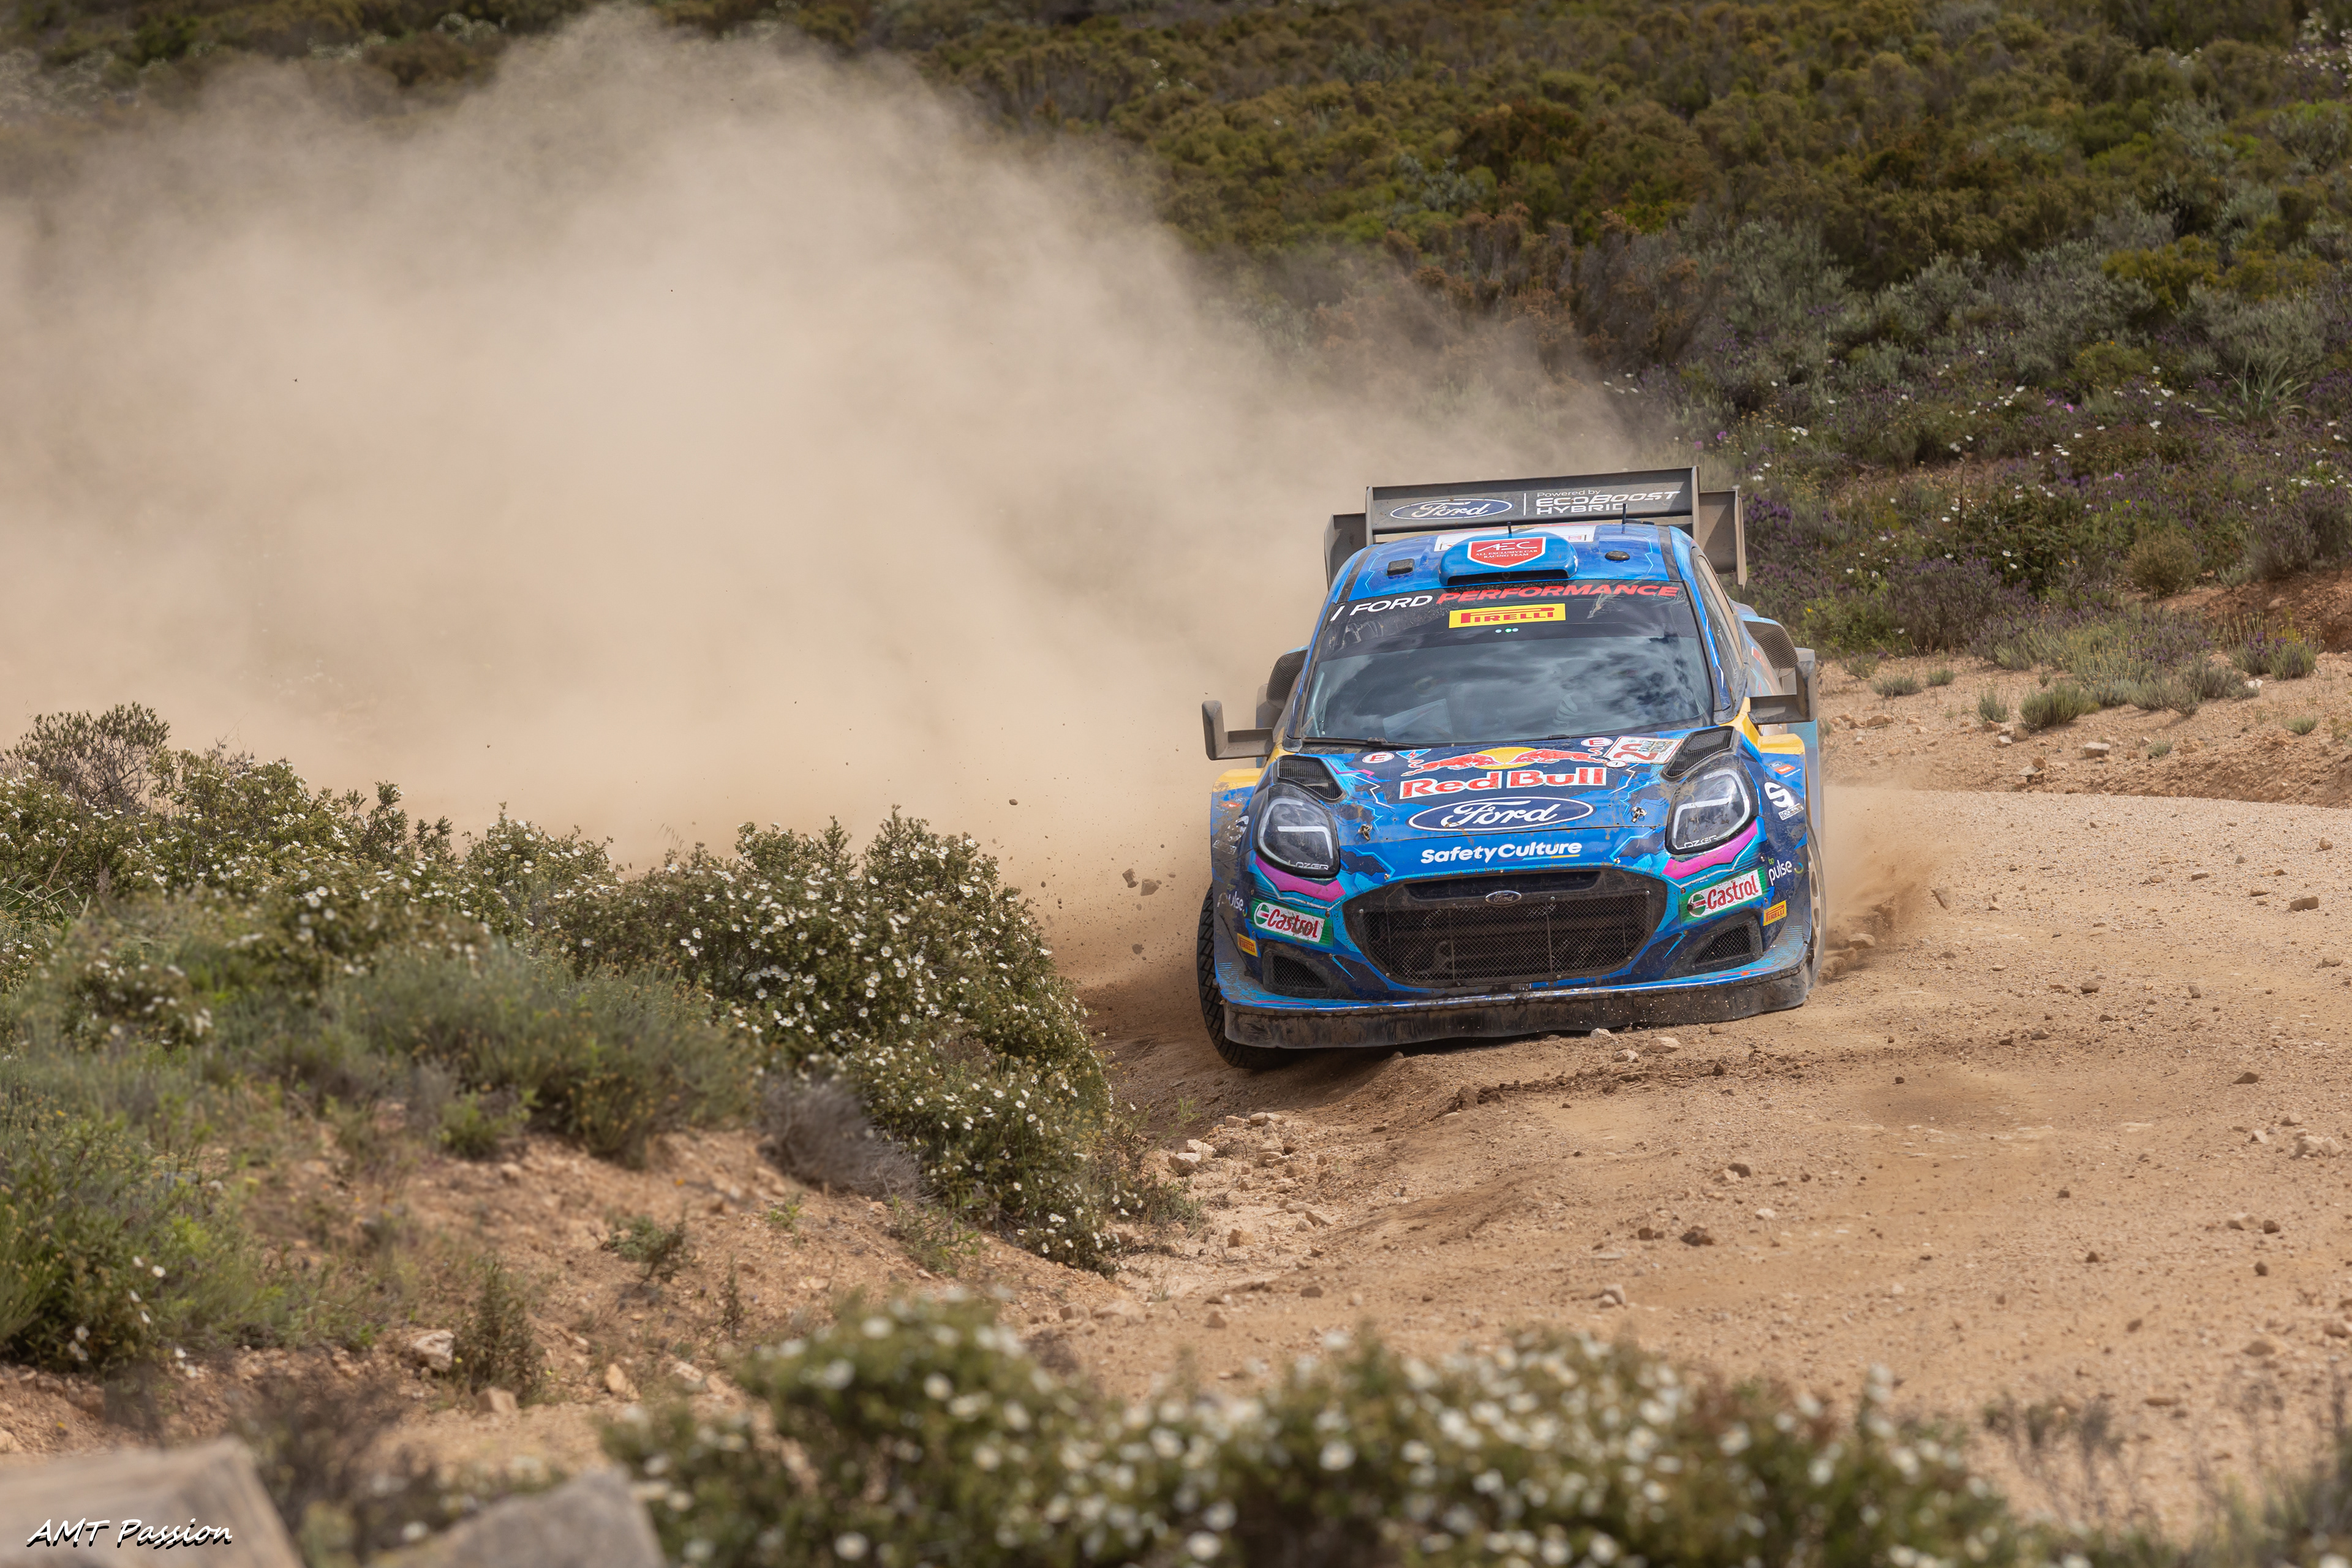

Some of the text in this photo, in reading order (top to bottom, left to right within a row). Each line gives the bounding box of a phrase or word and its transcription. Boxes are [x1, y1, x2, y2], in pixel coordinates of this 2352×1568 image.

[1411, 501, 1491, 518] Ford
[1536, 503, 1627, 515] HYBRID
[1477, 541, 1537, 552] AEC
[1349, 584, 1679, 616] FORD PERFORMANCE
[1460, 607, 1555, 624] PIRELLI
[1400, 767, 1607, 799] Red Bull
[1441, 800, 1561, 827] Ford
[1420, 842, 1583, 863] SafetyCulture
[1768, 860, 1792, 886] pulse
[1707, 875, 1758, 910] Castrol
[1267, 908, 1319, 938] Castrol
[1766, 905, 1785, 922] PIRELLI
[1239, 937, 1256, 953] PIRELLI
